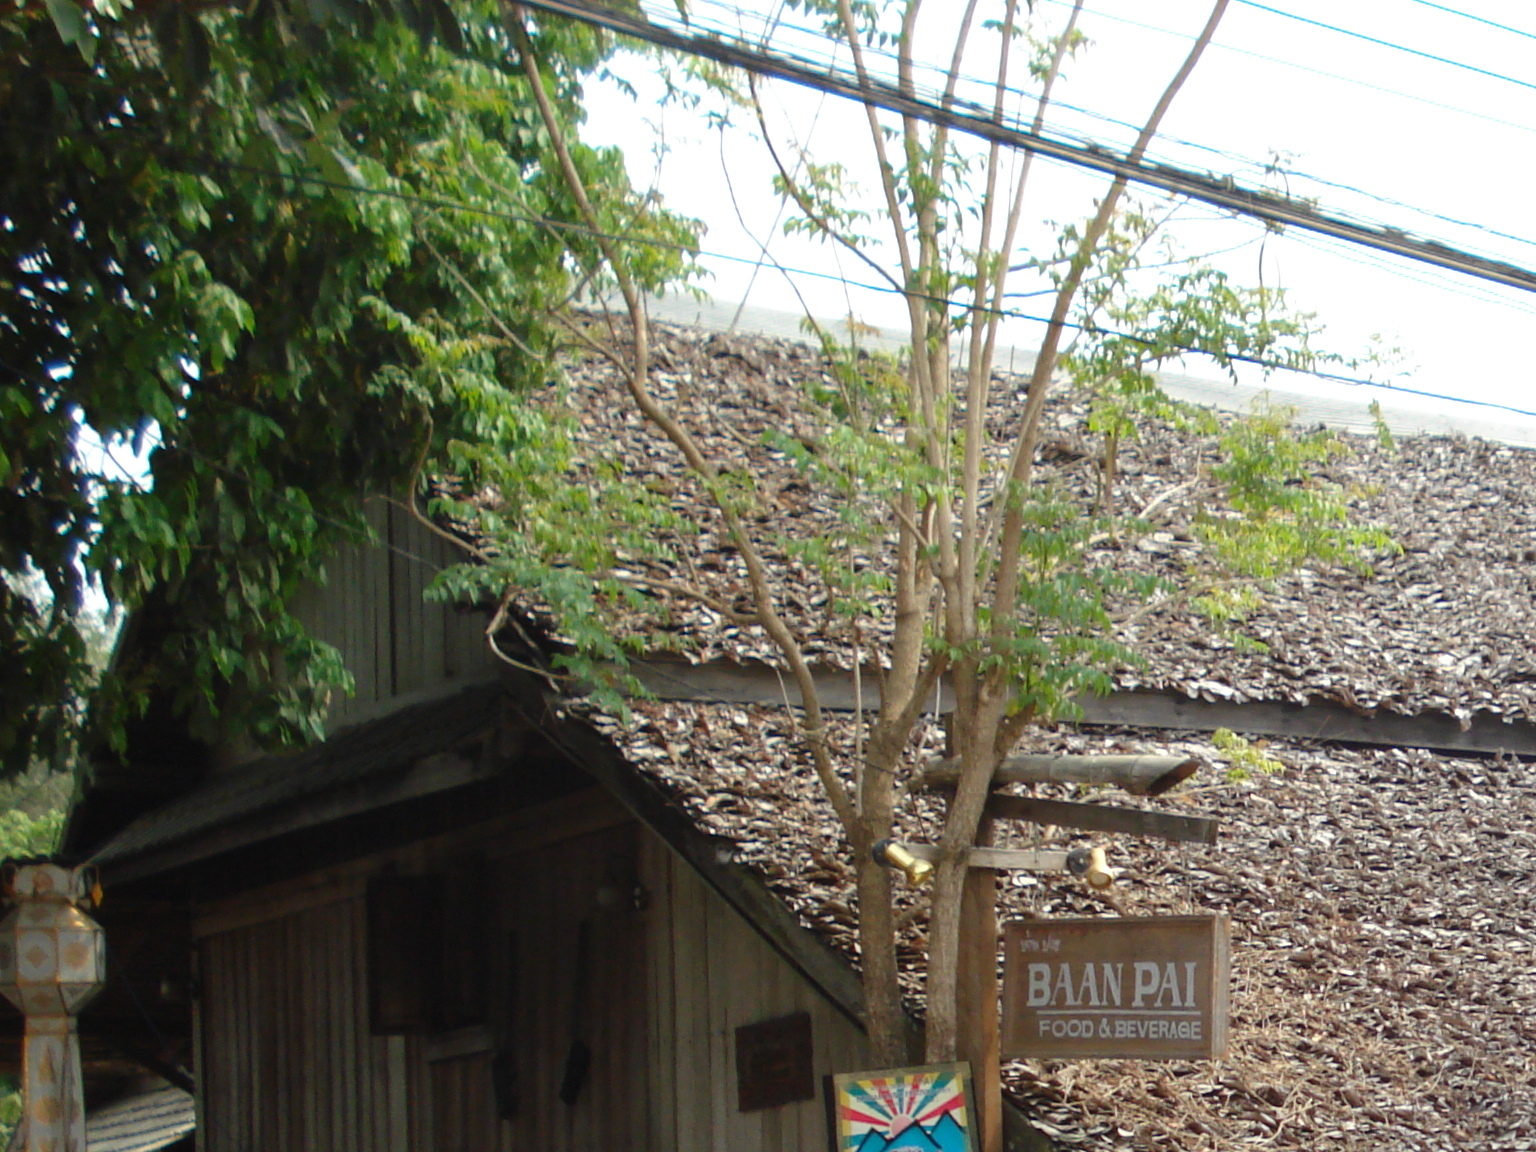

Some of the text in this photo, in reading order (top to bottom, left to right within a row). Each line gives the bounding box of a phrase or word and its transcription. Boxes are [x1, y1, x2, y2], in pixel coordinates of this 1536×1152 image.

[1026, 961, 1197, 1008] BAAN PAI
[1039, 1017, 1202, 1040] FOOD & BEVERAGE
